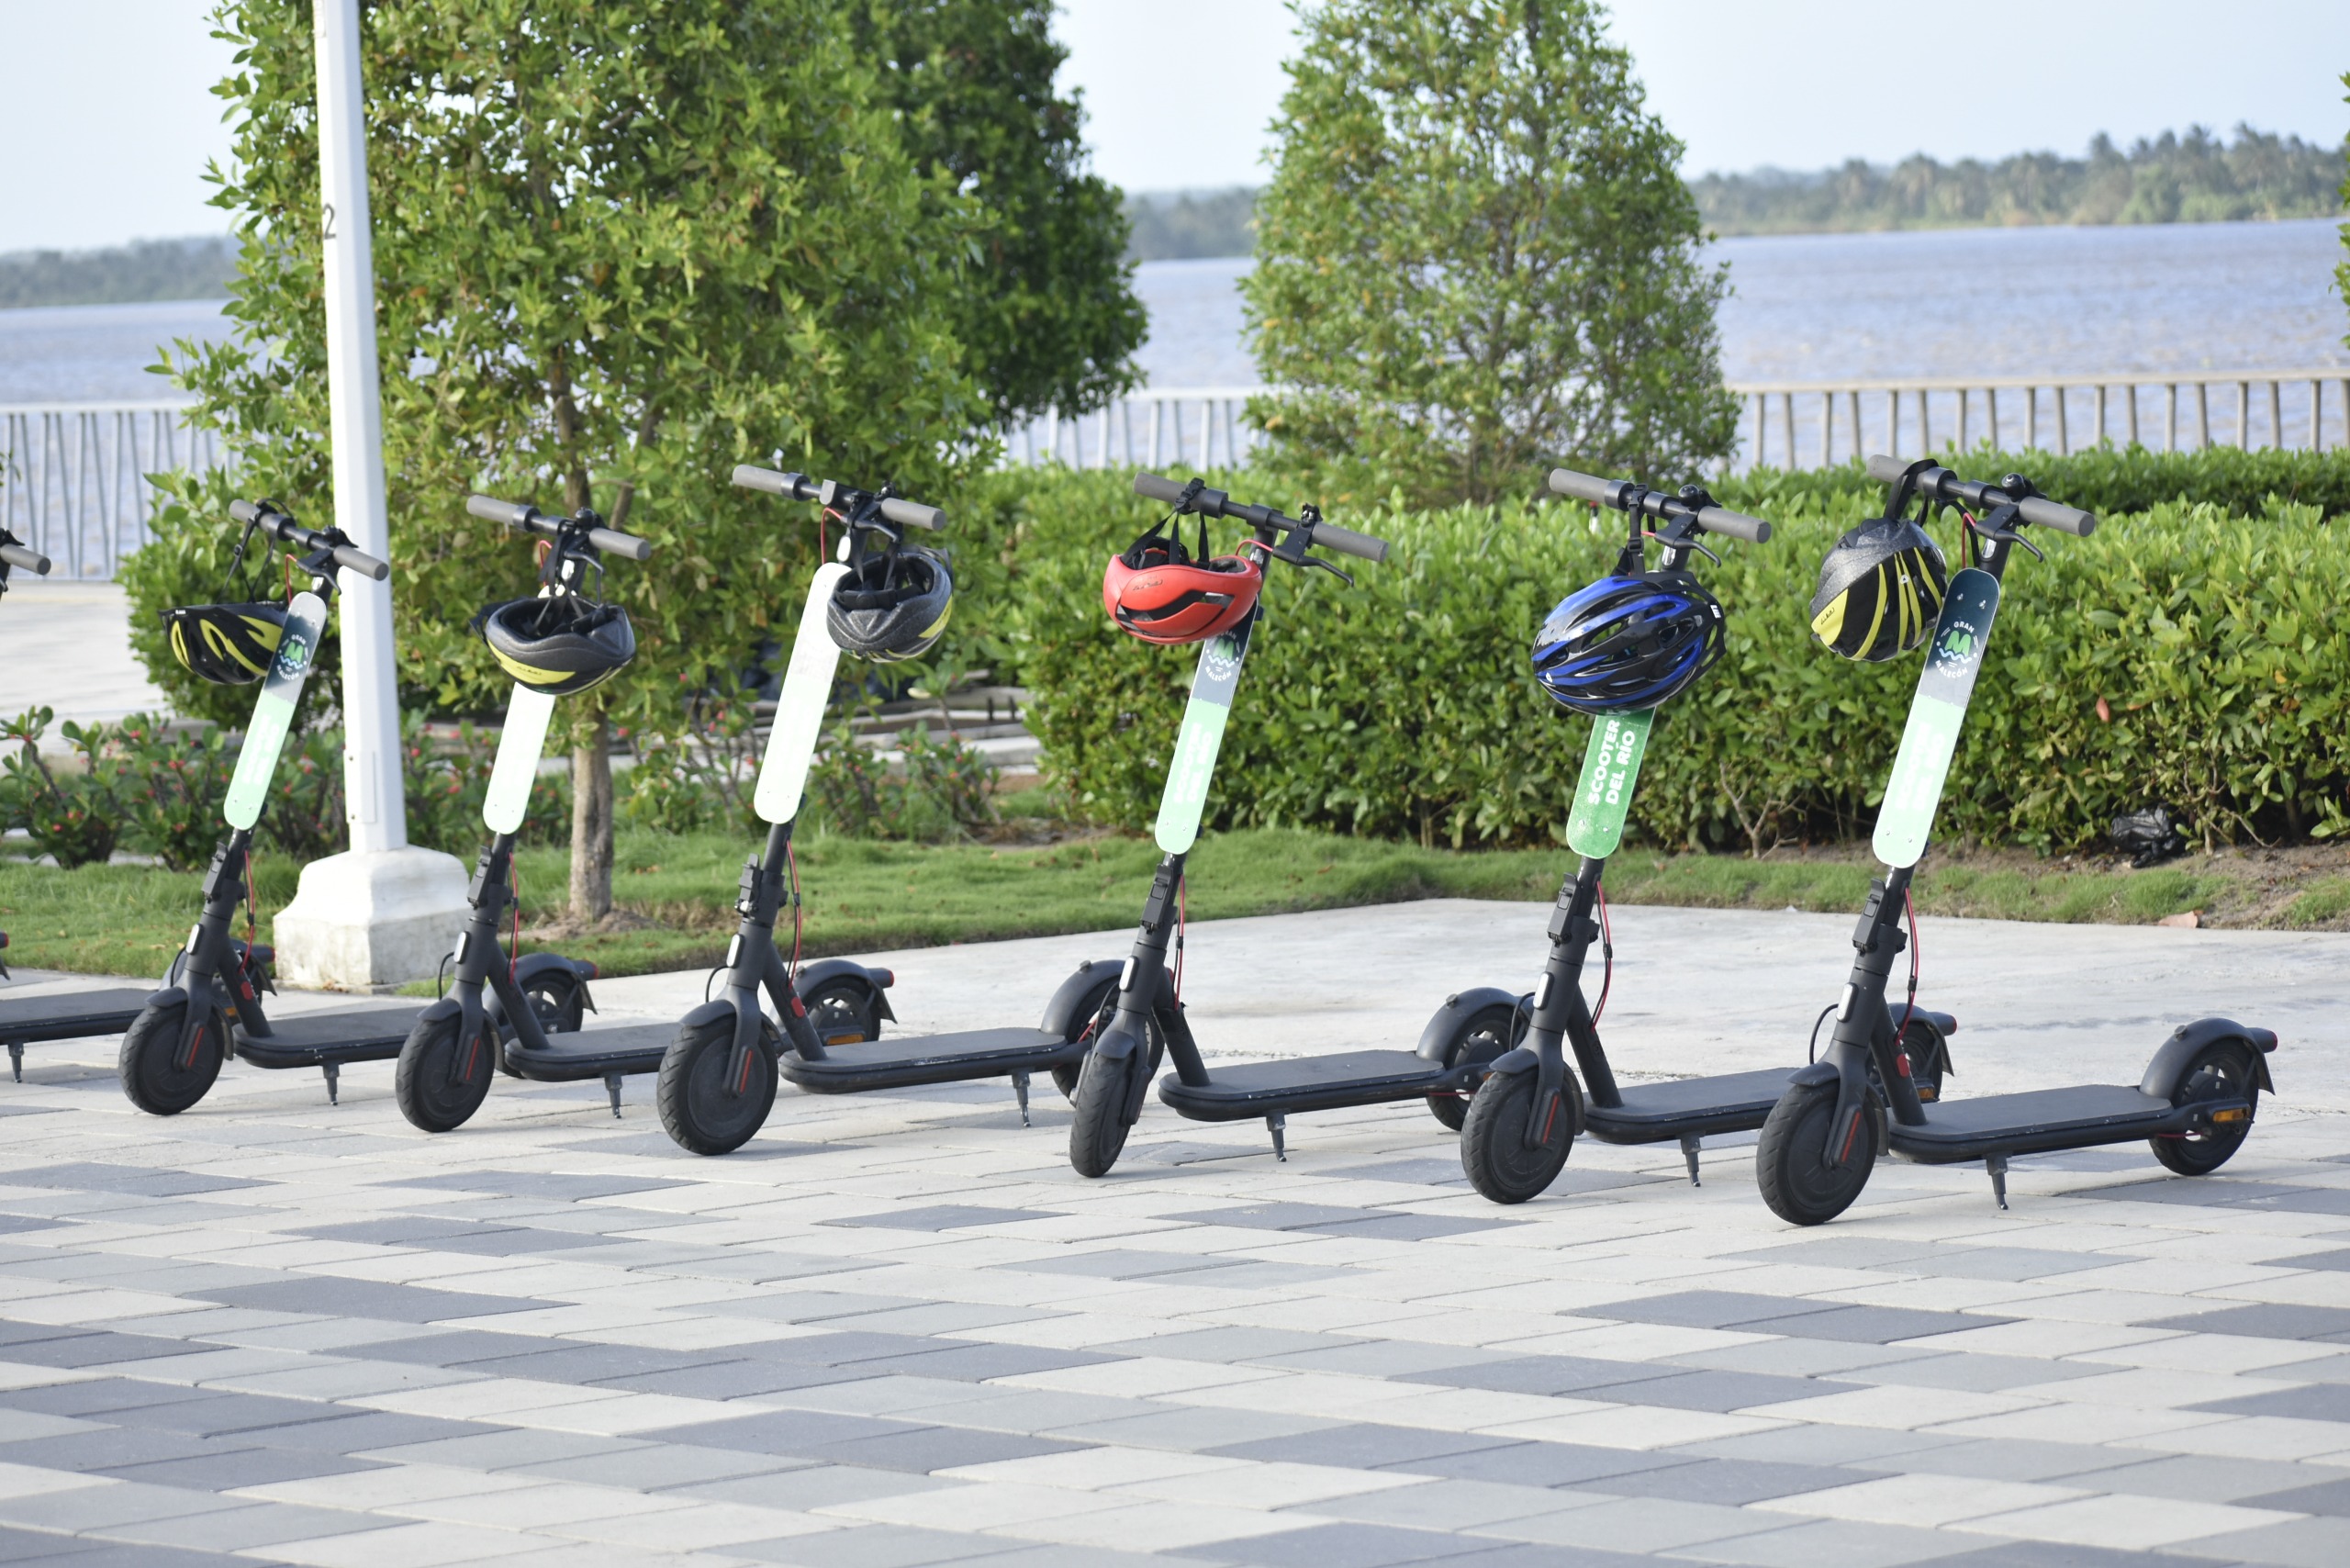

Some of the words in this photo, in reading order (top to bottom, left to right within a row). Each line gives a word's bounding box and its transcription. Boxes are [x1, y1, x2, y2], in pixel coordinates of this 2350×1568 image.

[322, 203, 336, 240] 2
[1953, 621, 1975, 633] GRAN
[1205, 666, 1232, 682] MALECÓN
[1935, 660, 1968, 678] MALECÓN
[1588, 720, 1620, 805] SCOOTER
[1606, 770, 1626, 805] DEL
[1616, 730, 1636, 766] RÍO
